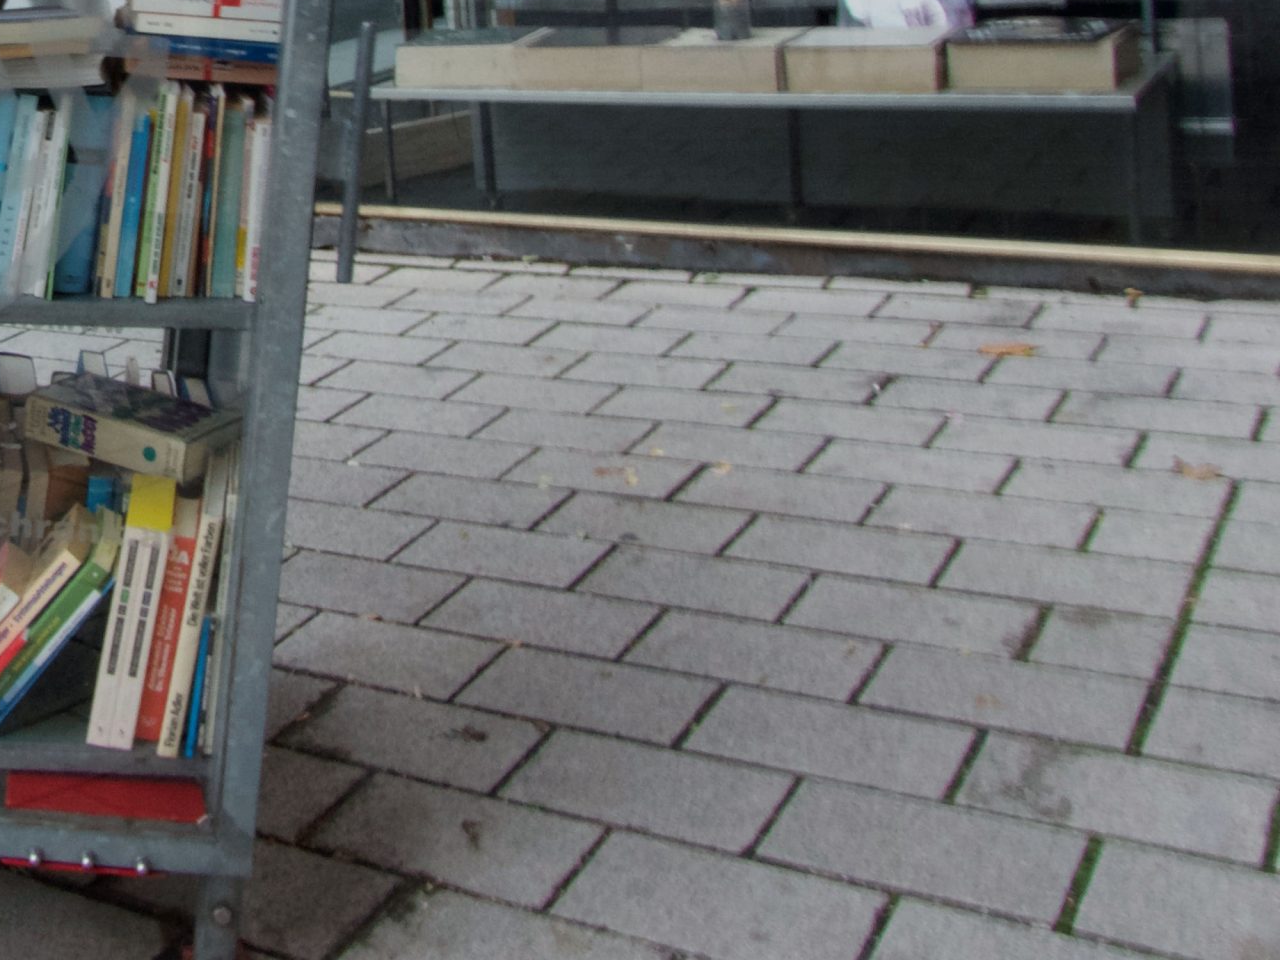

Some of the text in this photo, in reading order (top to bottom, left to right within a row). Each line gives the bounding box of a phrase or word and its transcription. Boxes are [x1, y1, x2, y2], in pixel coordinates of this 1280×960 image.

[186, 521, 216, 626] Die Welt ist voller Farben
[170, 691, 184, 716] Adler
